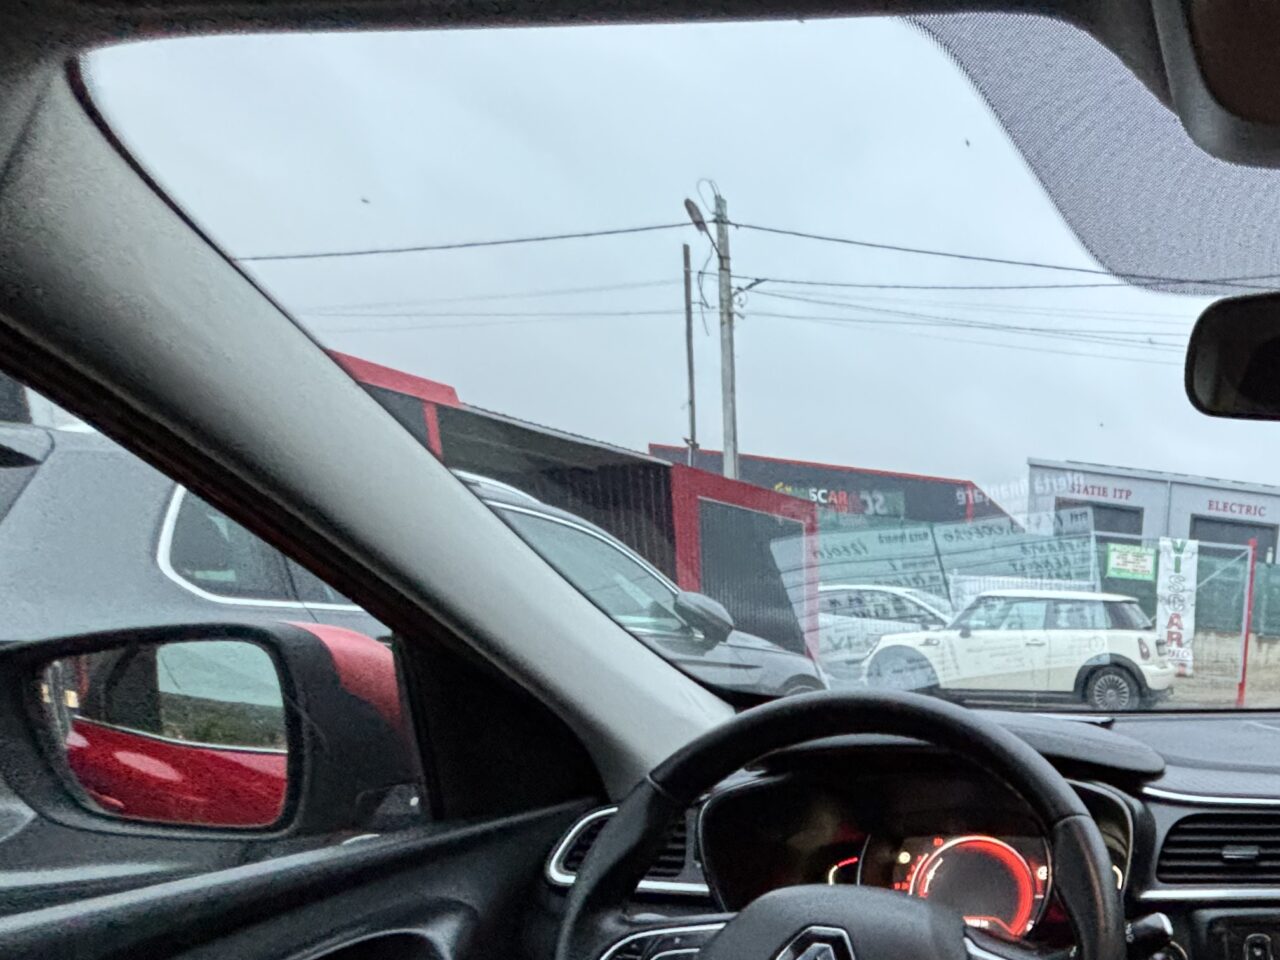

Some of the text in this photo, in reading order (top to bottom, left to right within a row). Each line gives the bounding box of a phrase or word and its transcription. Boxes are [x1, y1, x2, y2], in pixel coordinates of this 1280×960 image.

[1113, 489, 1133, 500] ITP
[1208, 500, 1267, 517] ELECTRIC
[1167, 540, 1188, 648] VISCAR
